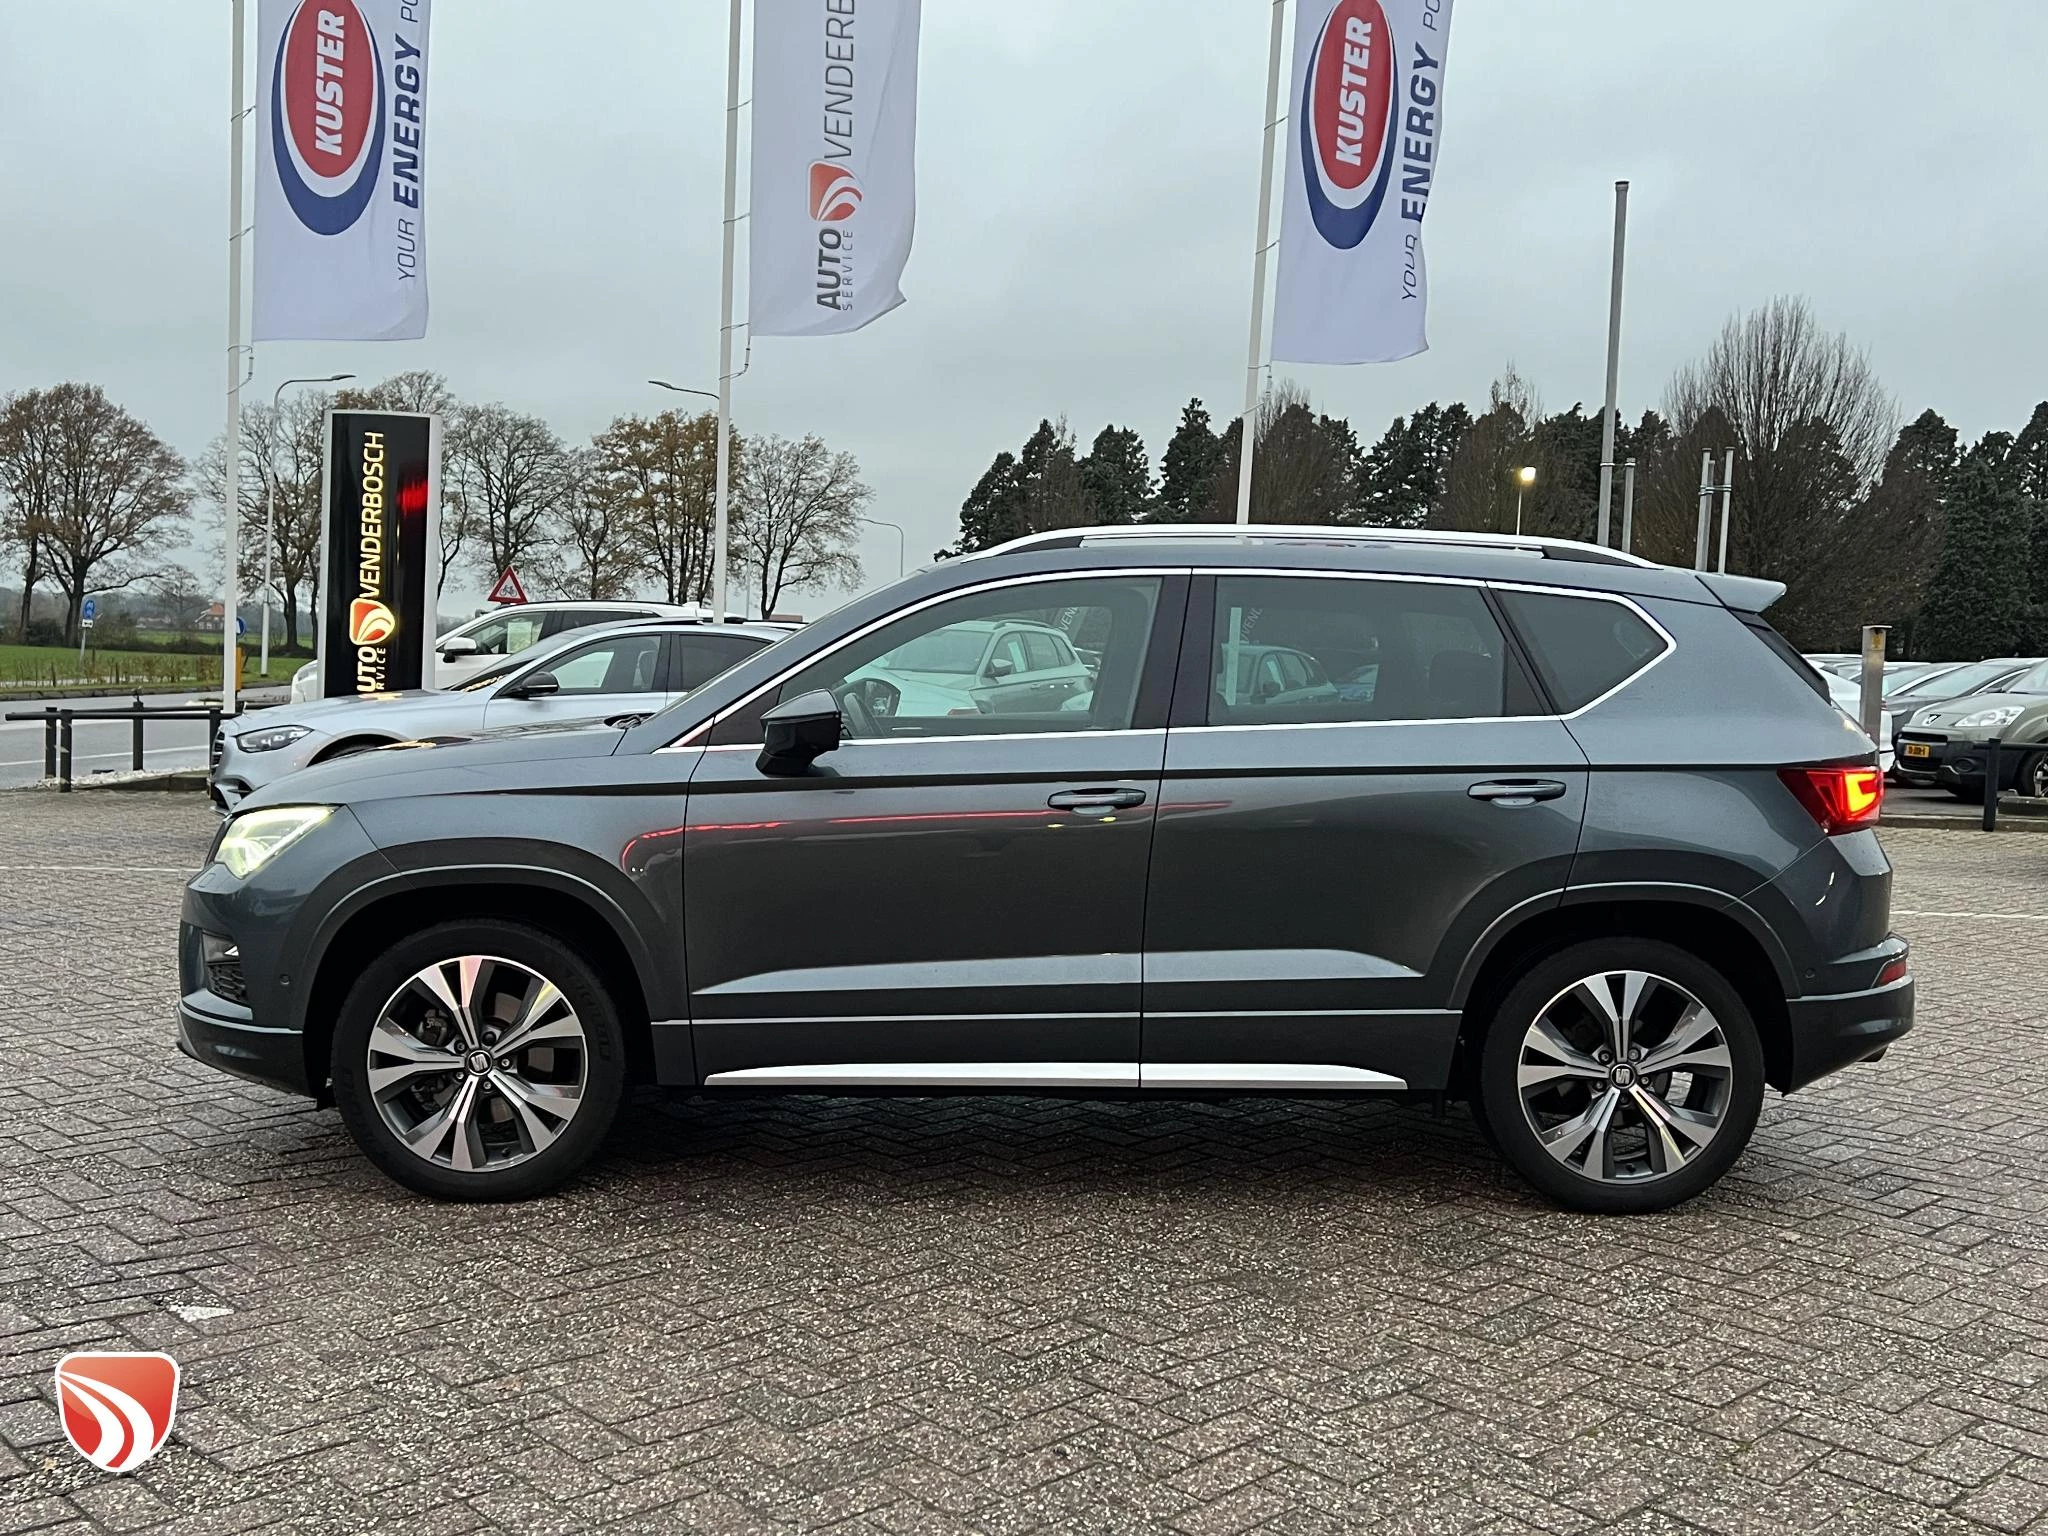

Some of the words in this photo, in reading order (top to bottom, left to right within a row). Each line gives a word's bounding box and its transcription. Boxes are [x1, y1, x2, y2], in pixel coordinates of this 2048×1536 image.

[315, 9, 345, 156] KUSTER
[393, 33, 421, 209] ENERGY
[1335, 15, 1373, 167] KUSTER
[1401, 42, 1439, 224] ENERGY
[397, 218, 416, 281] YOUR
[816, 228, 843, 311] AUTO
[842, 229, 854, 312] SERVICE
[359, 431, 384, 600] VENDERBOSCH
[356, 645, 378, 693] UTO
[375, 647, 387, 691] RVICE
